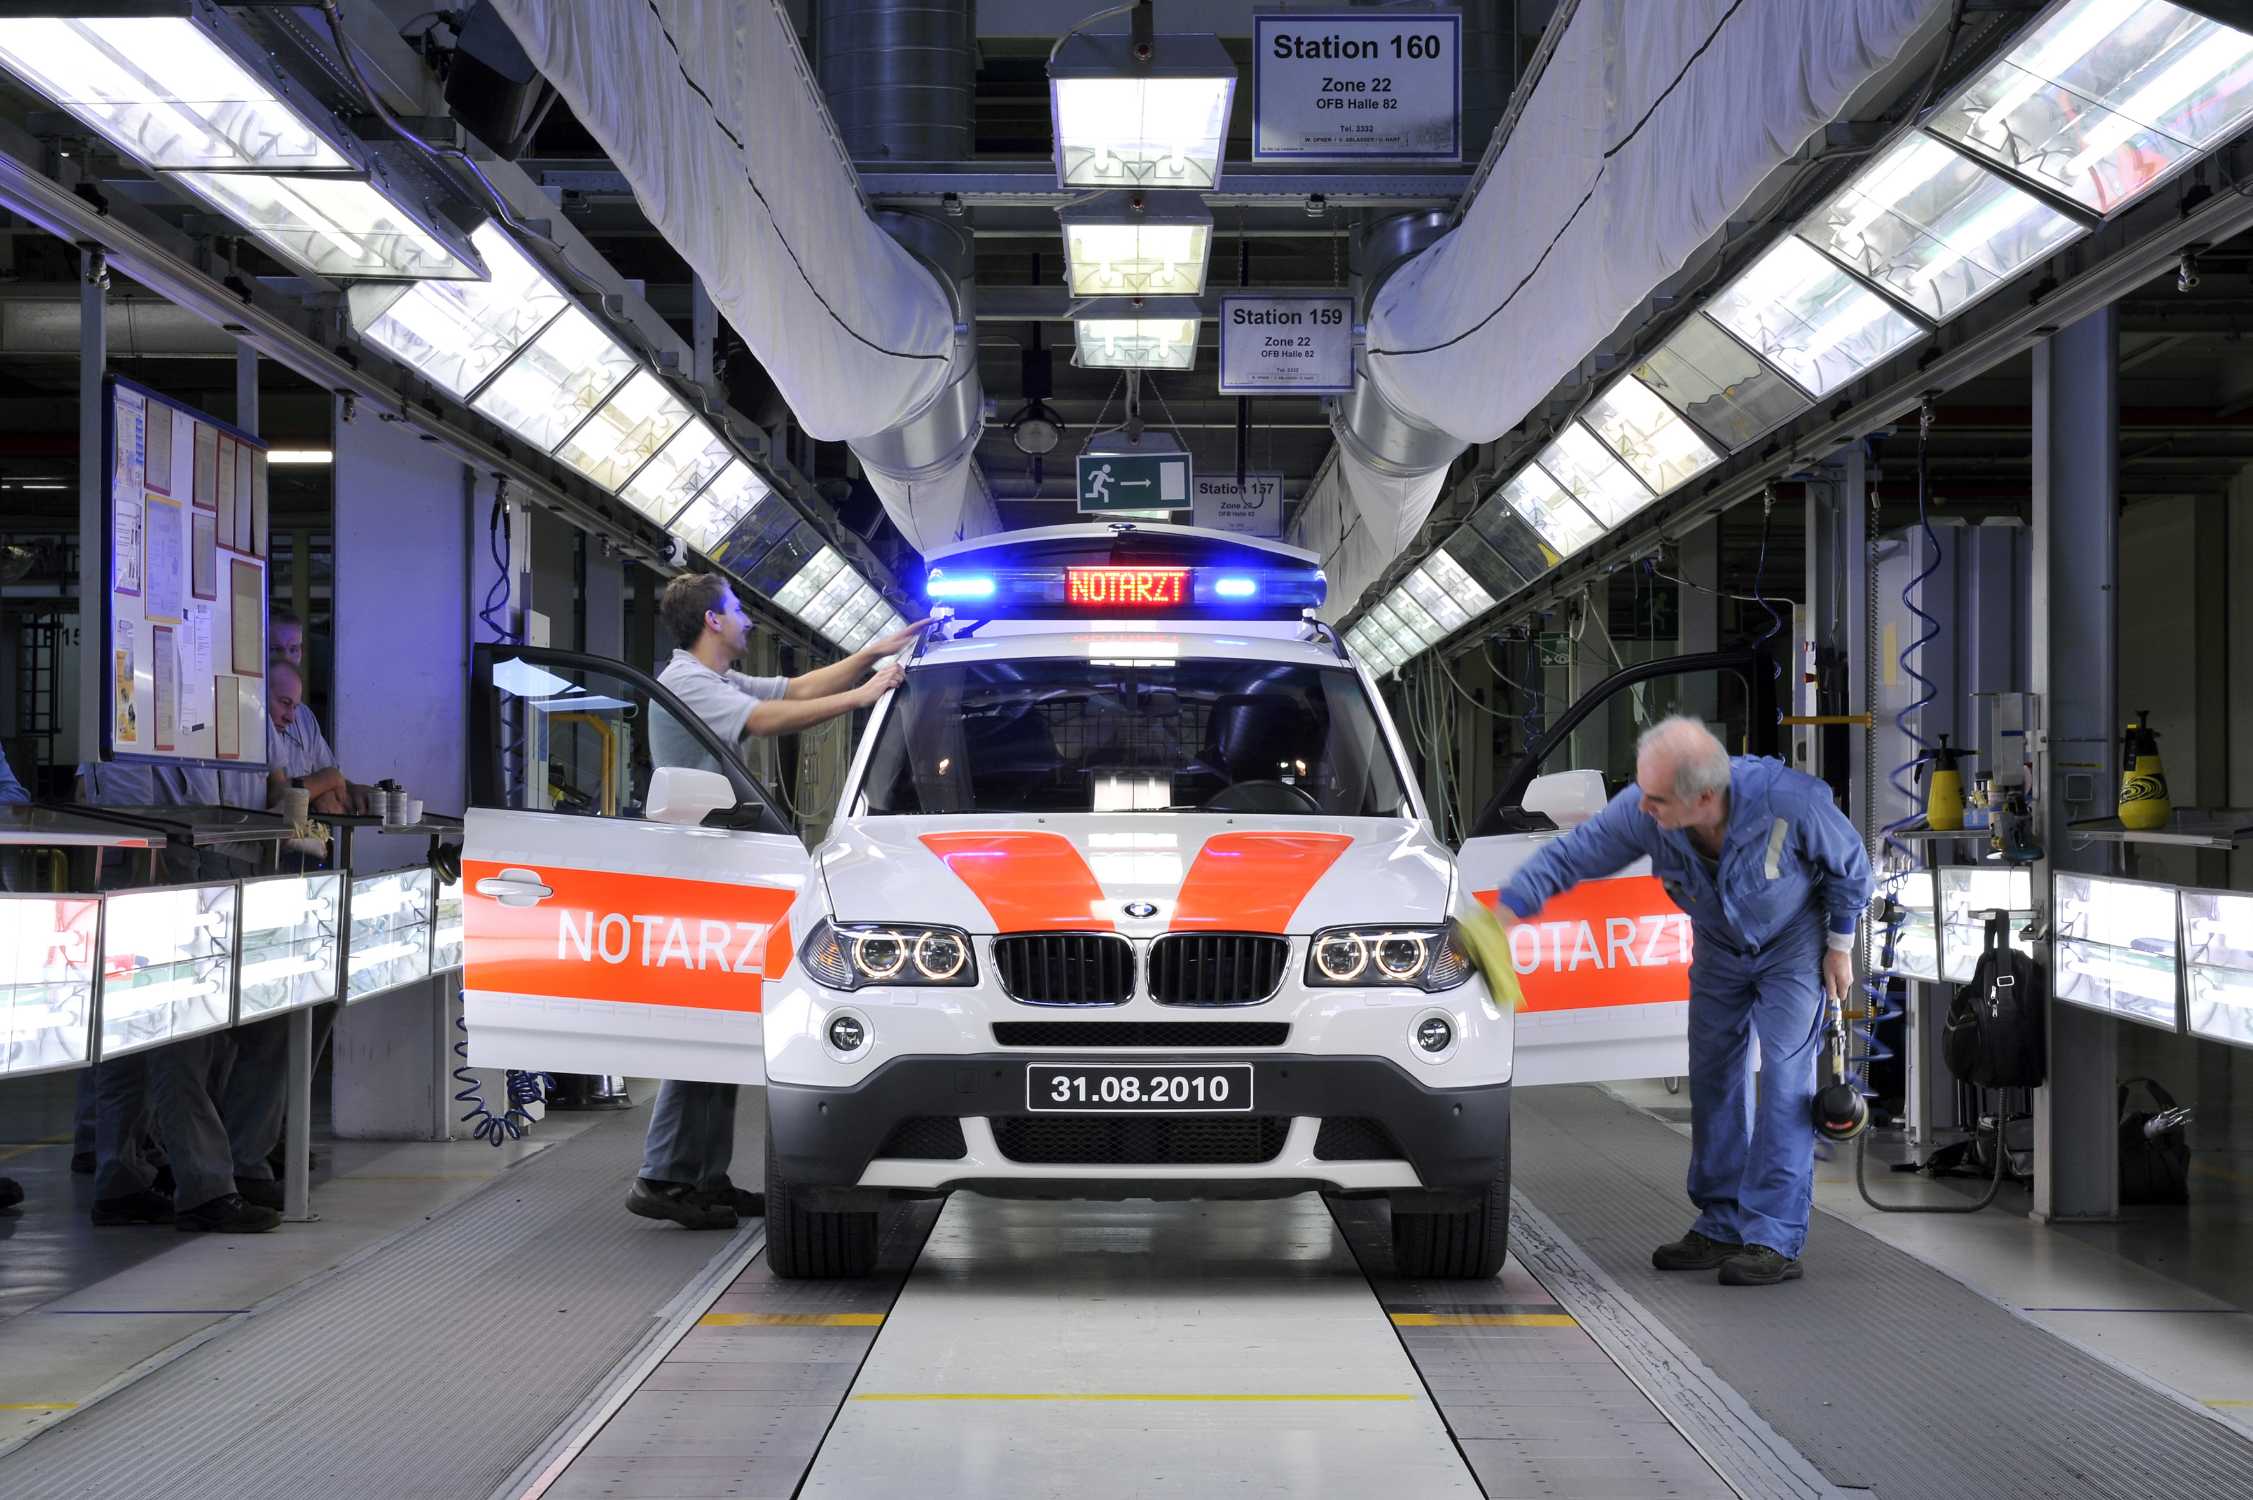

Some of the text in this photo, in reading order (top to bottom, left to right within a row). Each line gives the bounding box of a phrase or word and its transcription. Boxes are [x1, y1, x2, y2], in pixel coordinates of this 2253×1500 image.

[1273, 34, 1441, 59] Station 160
[1321, 77, 1392, 92] Zone 22
[1316, 98, 1398, 109] OFB Halle 82
[1340, 125, 1353, 133] Tel.
[1233, 308, 1343, 325] Station 159
[1265, 336, 1311, 347] Zone 22
[1261, 350, 1279, 358] OFB
[1199, 482, 1274, 495] Station 157
[1220, 502, 1241, 510] Zone
[1071, 571, 1185, 602] NOTARZT
[557, 909, 774, 975] NOTARZ
[1509, 913, 1692, 975] OTARZT
[1051, 1075, 1230, 1102] 31.08.2010
